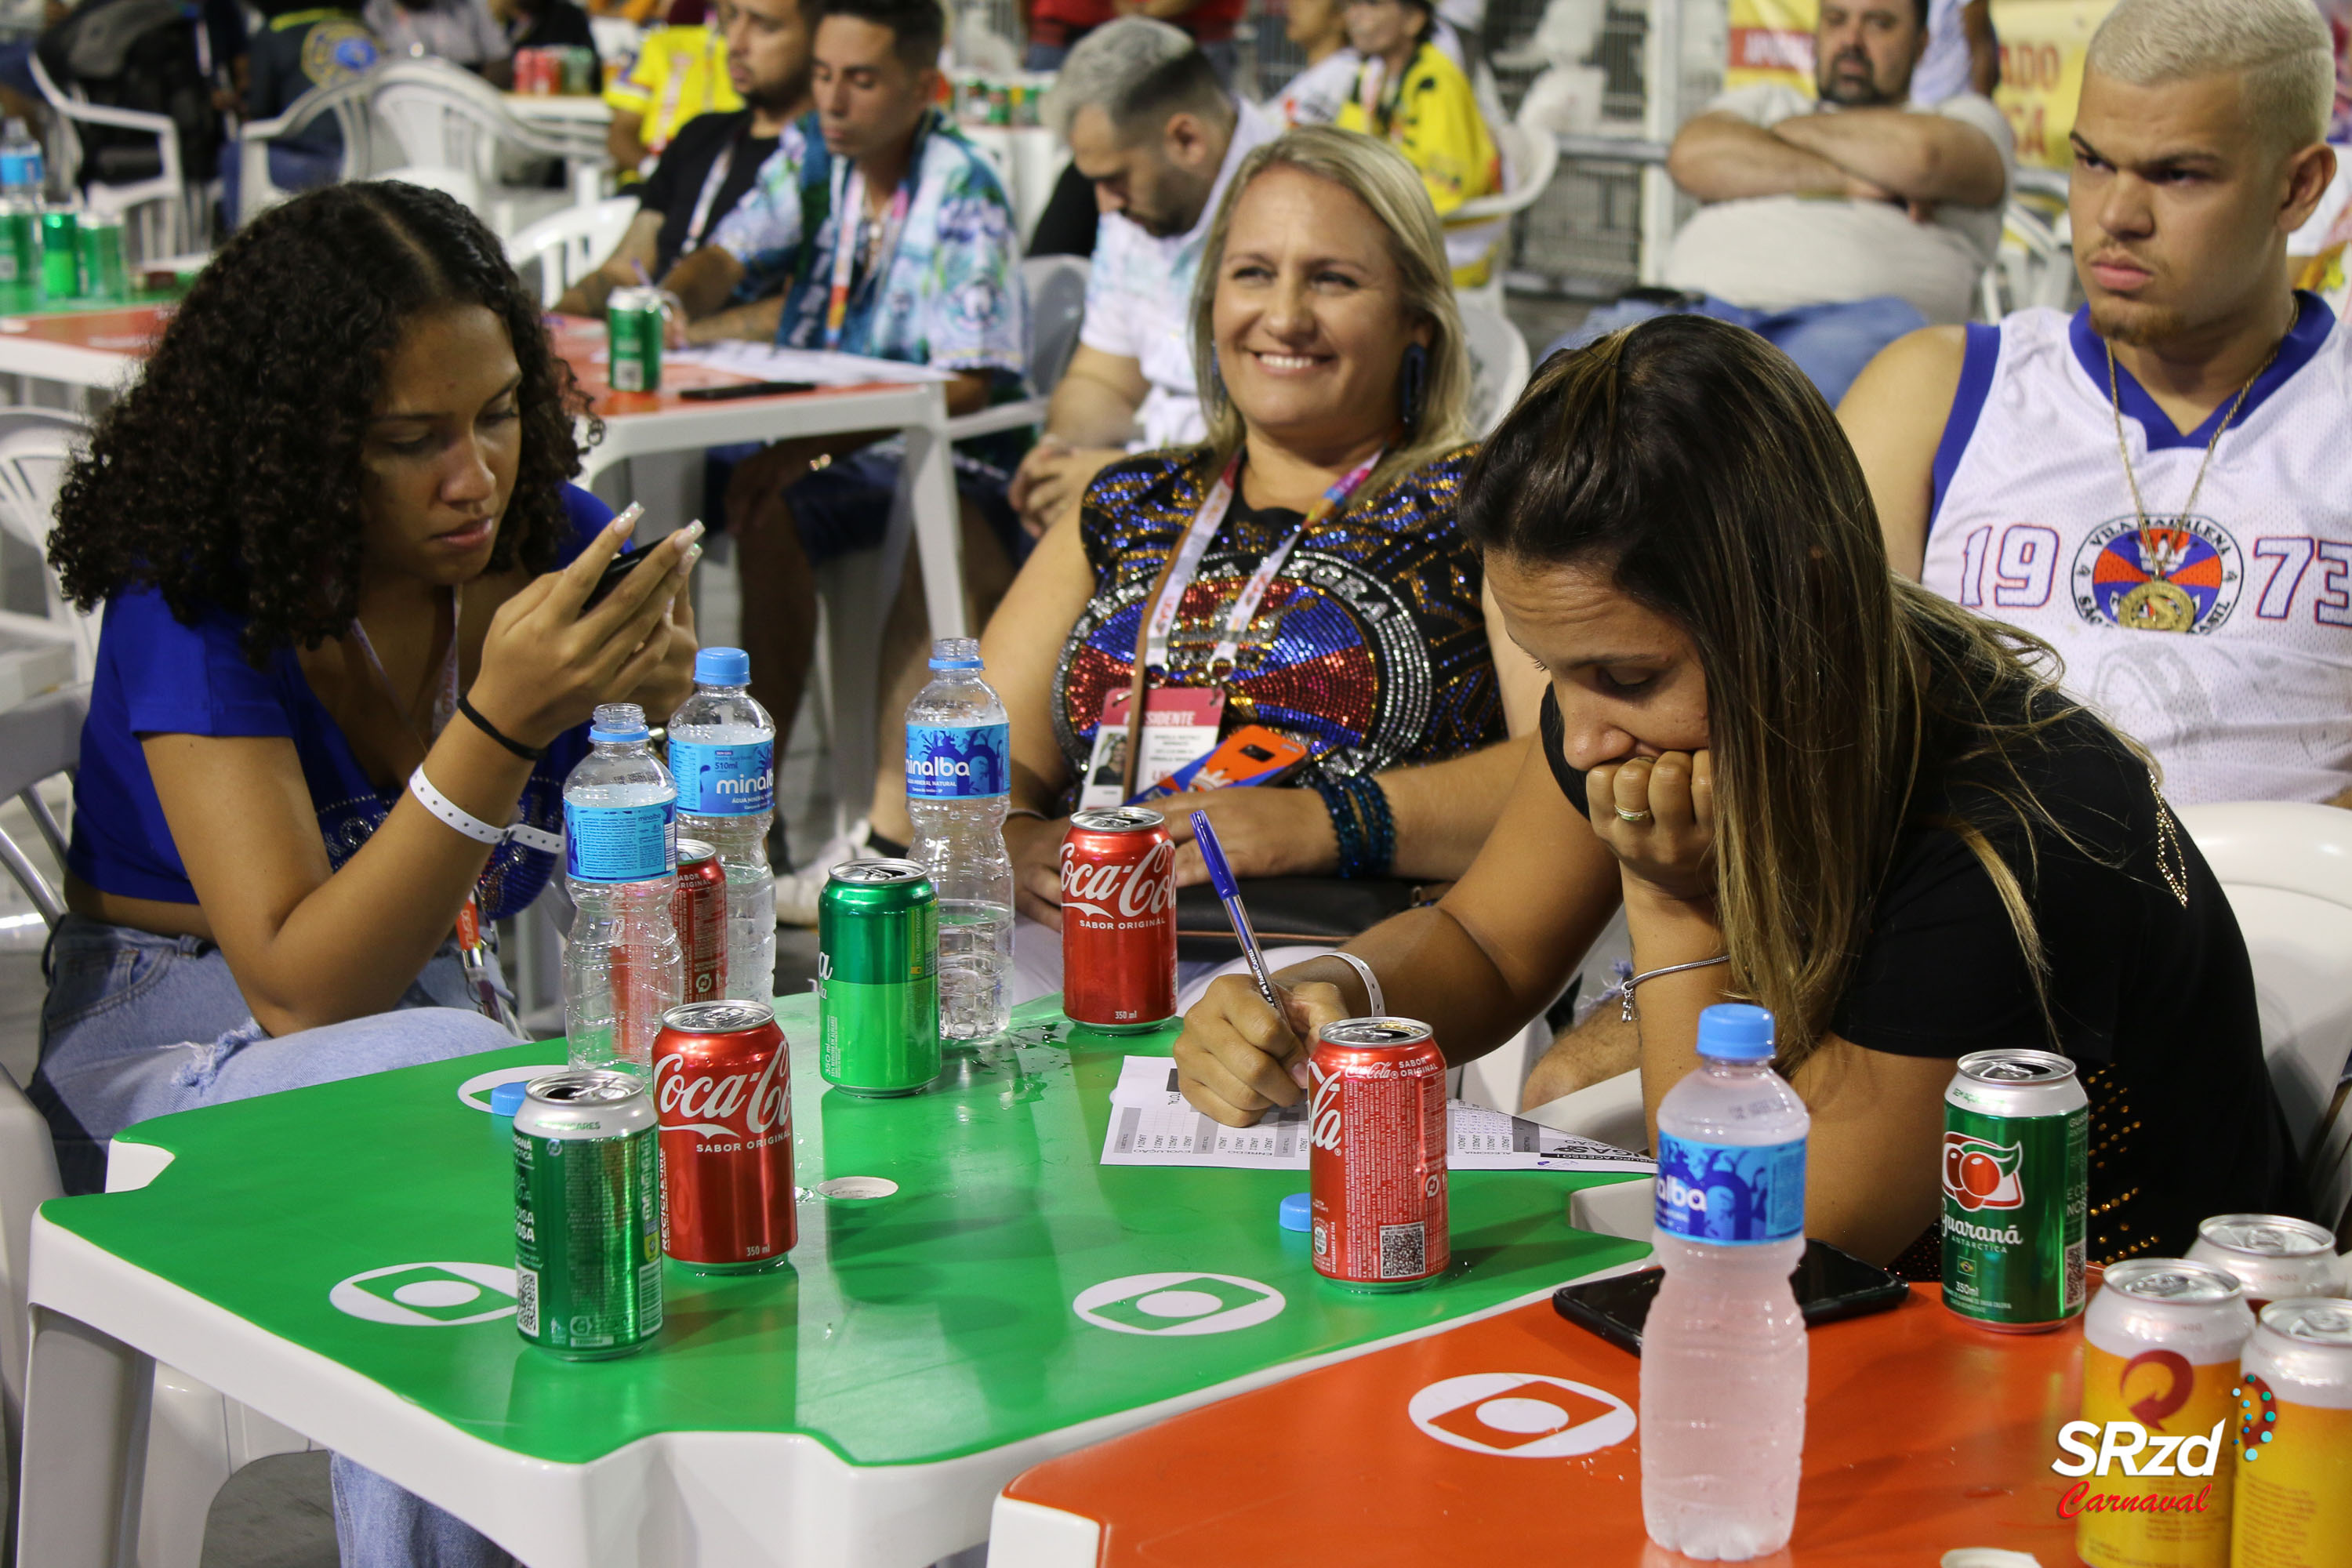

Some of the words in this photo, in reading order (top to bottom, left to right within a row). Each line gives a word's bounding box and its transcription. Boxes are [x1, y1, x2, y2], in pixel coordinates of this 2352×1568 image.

[2089, 521, 2132, 550] VILA
[1960, 524, 2060, 608] 19
[677, 873, 701, 881] ABOR
[679, 879, 712, 889] RIGINAL
[1079, 919, 1114, 930] SABOR
[1118, 917, 1166, 930] ORIGINAL
[1114, 1010, 1128, 1019] 350
[1128, 1010, 1138, 1018] ml
[1399, 1058, 1427, 1069] SABOR
[1400, 1064, 1439, 1077] ORIGINAL
[696, 1143, 742, 1153] SABOR
[746, 1131, 791, 1149] ORIGINAL
[746, 1245, 760, 1257] 350
[762, 1243, 770, 1254] ml
[1951, 1235, 2008, 1254] ANTARCTICA
